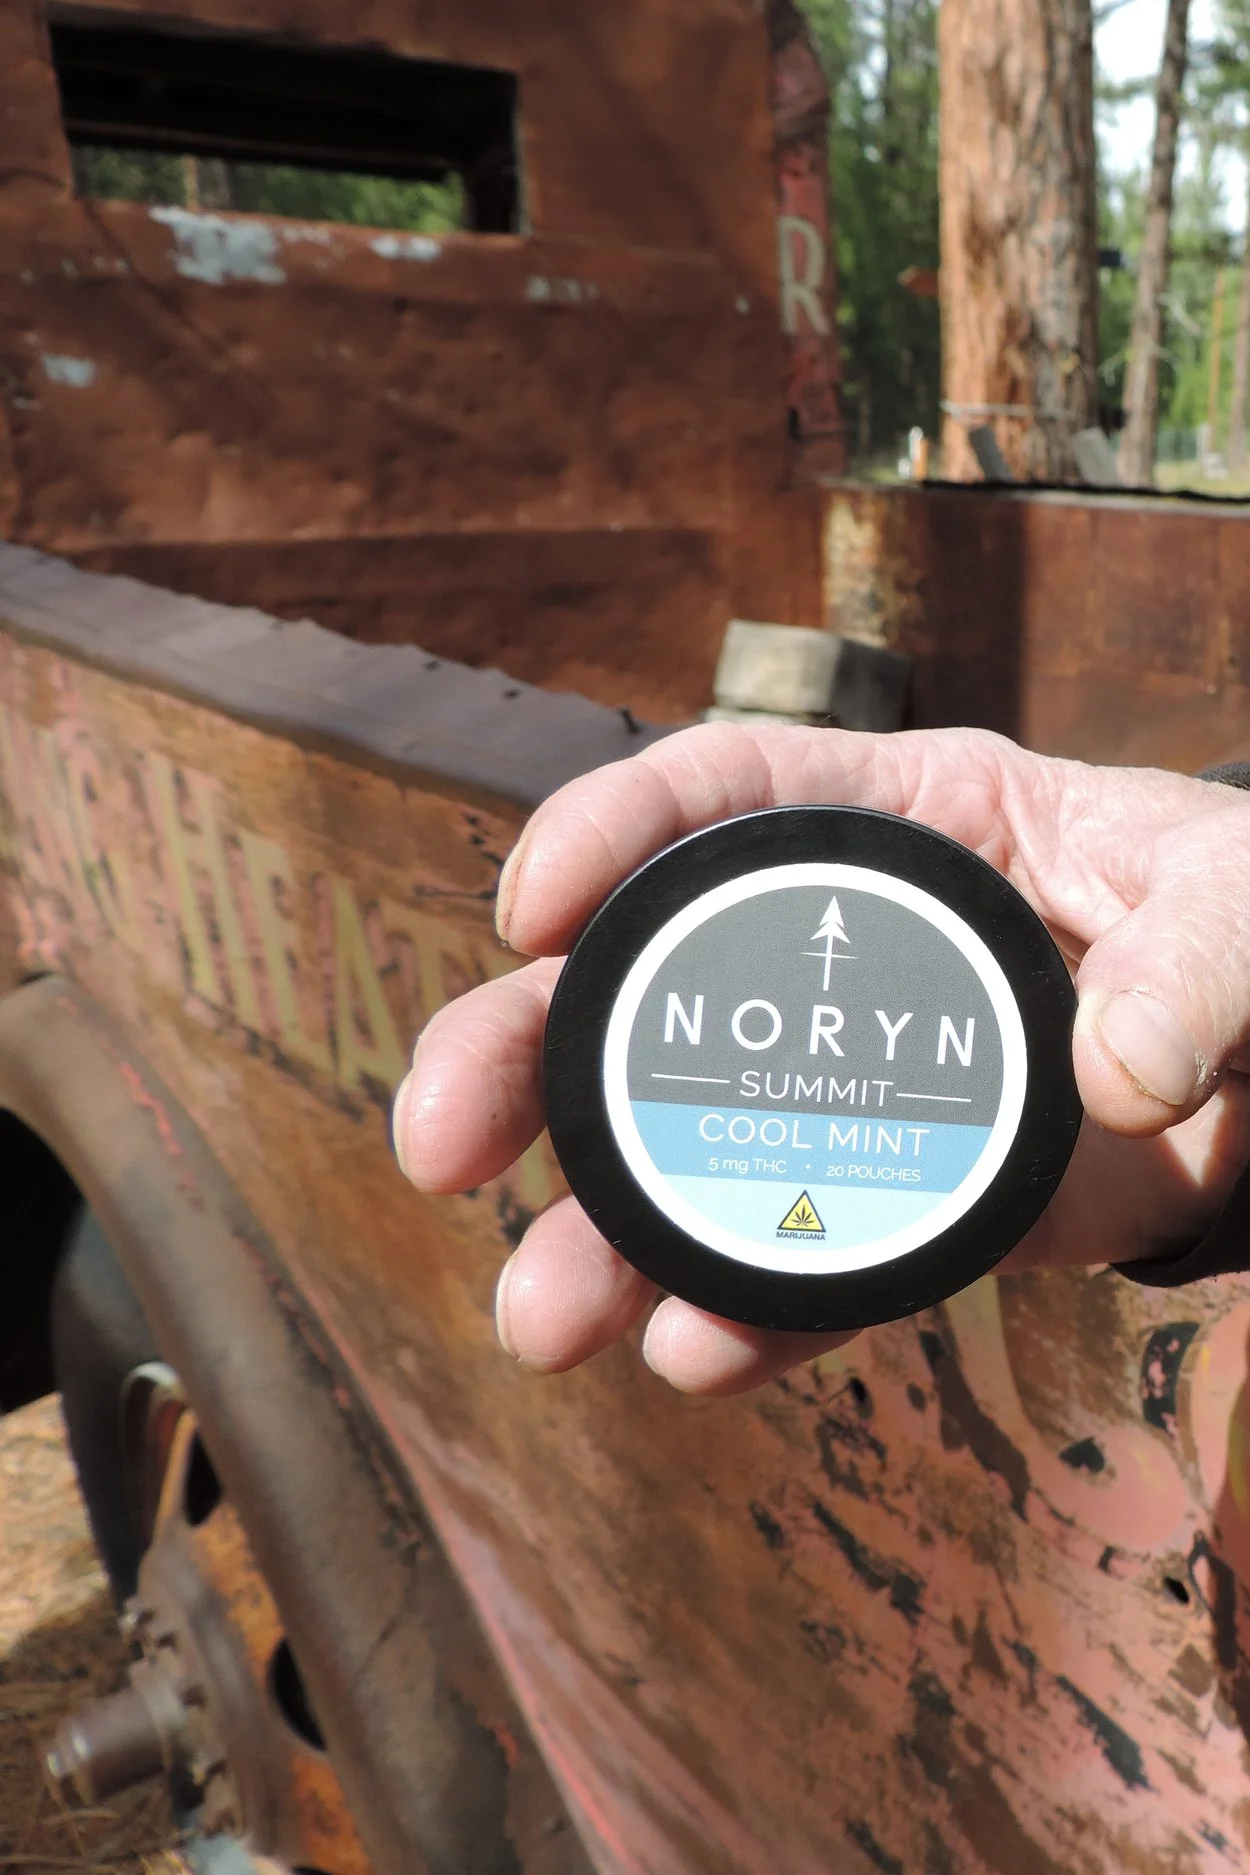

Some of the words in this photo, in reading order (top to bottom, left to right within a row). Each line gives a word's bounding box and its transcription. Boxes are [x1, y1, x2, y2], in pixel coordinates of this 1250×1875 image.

[777, 214, 831, 335] R
[663, 991, 976, 1067] NORYN
[739, 1070, 894, 1107] SUMMIT
[698, 1113, 813, 1149] COOL
[828, 1122, 930, 1156] MINT
[708, 1157, 719, 1171] 5
[722, 1158, 749, 1174] mg
[753, 1158, 787, 1174] THC
[826, 1165, 844, 1177] 20
[847, 1164, 921, 1182] POUCHES
[775, 1230, 826, 1241] MARIJUANA
